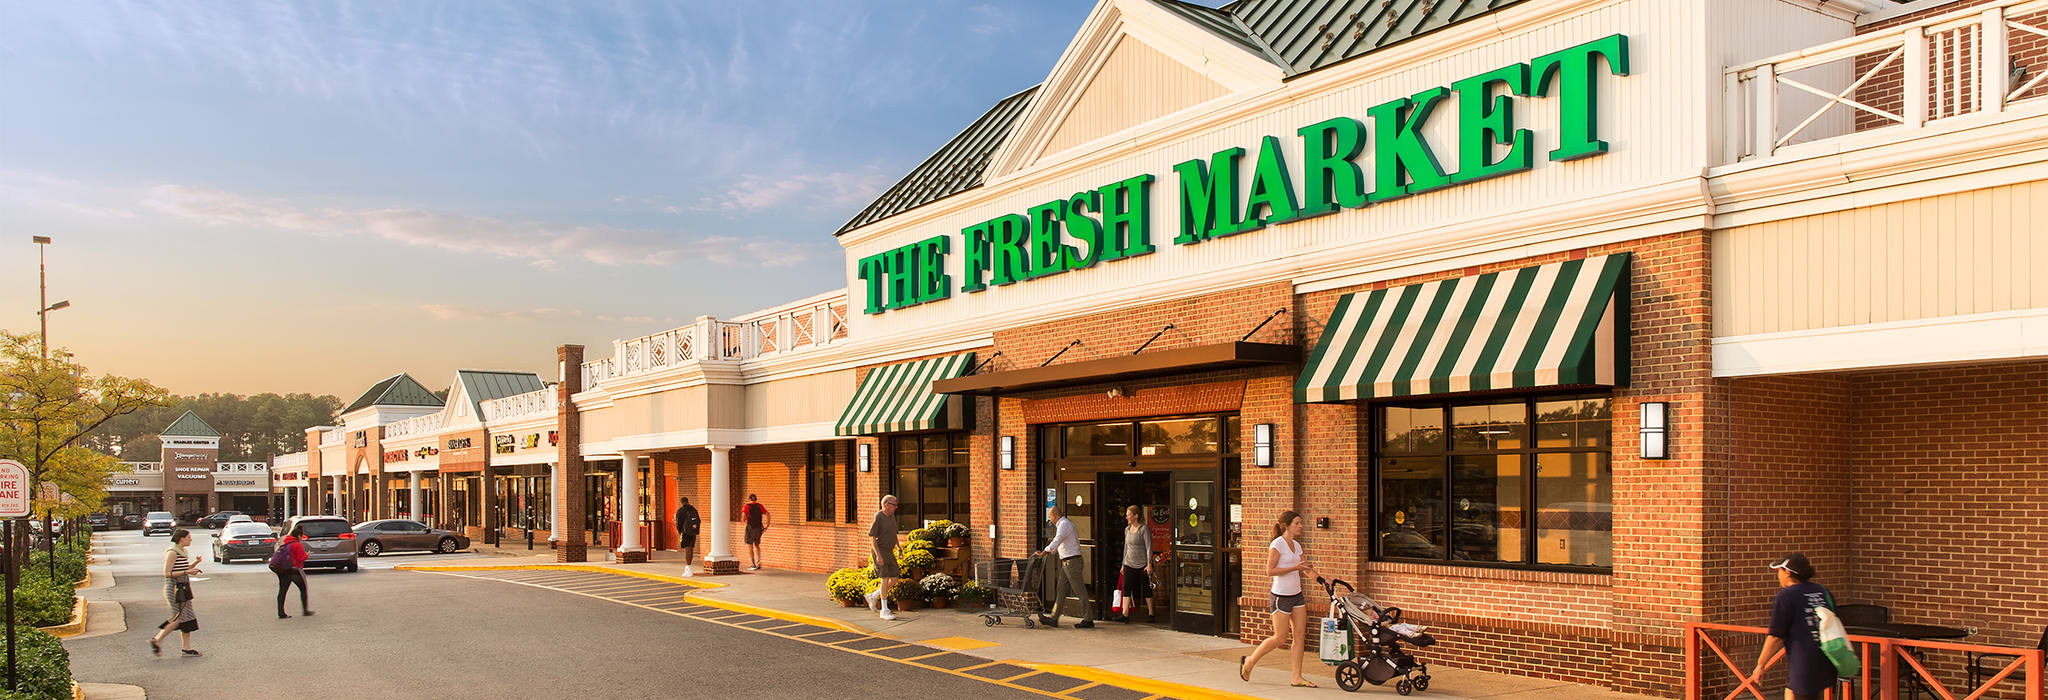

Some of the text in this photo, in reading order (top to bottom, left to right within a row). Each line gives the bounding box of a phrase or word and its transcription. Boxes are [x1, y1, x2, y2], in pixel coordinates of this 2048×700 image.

[858, 33, 1630, 315] THE FRESH MARKET
[1, 481, 16, 489] IRE
[0, 490, 19, 499] ANE
